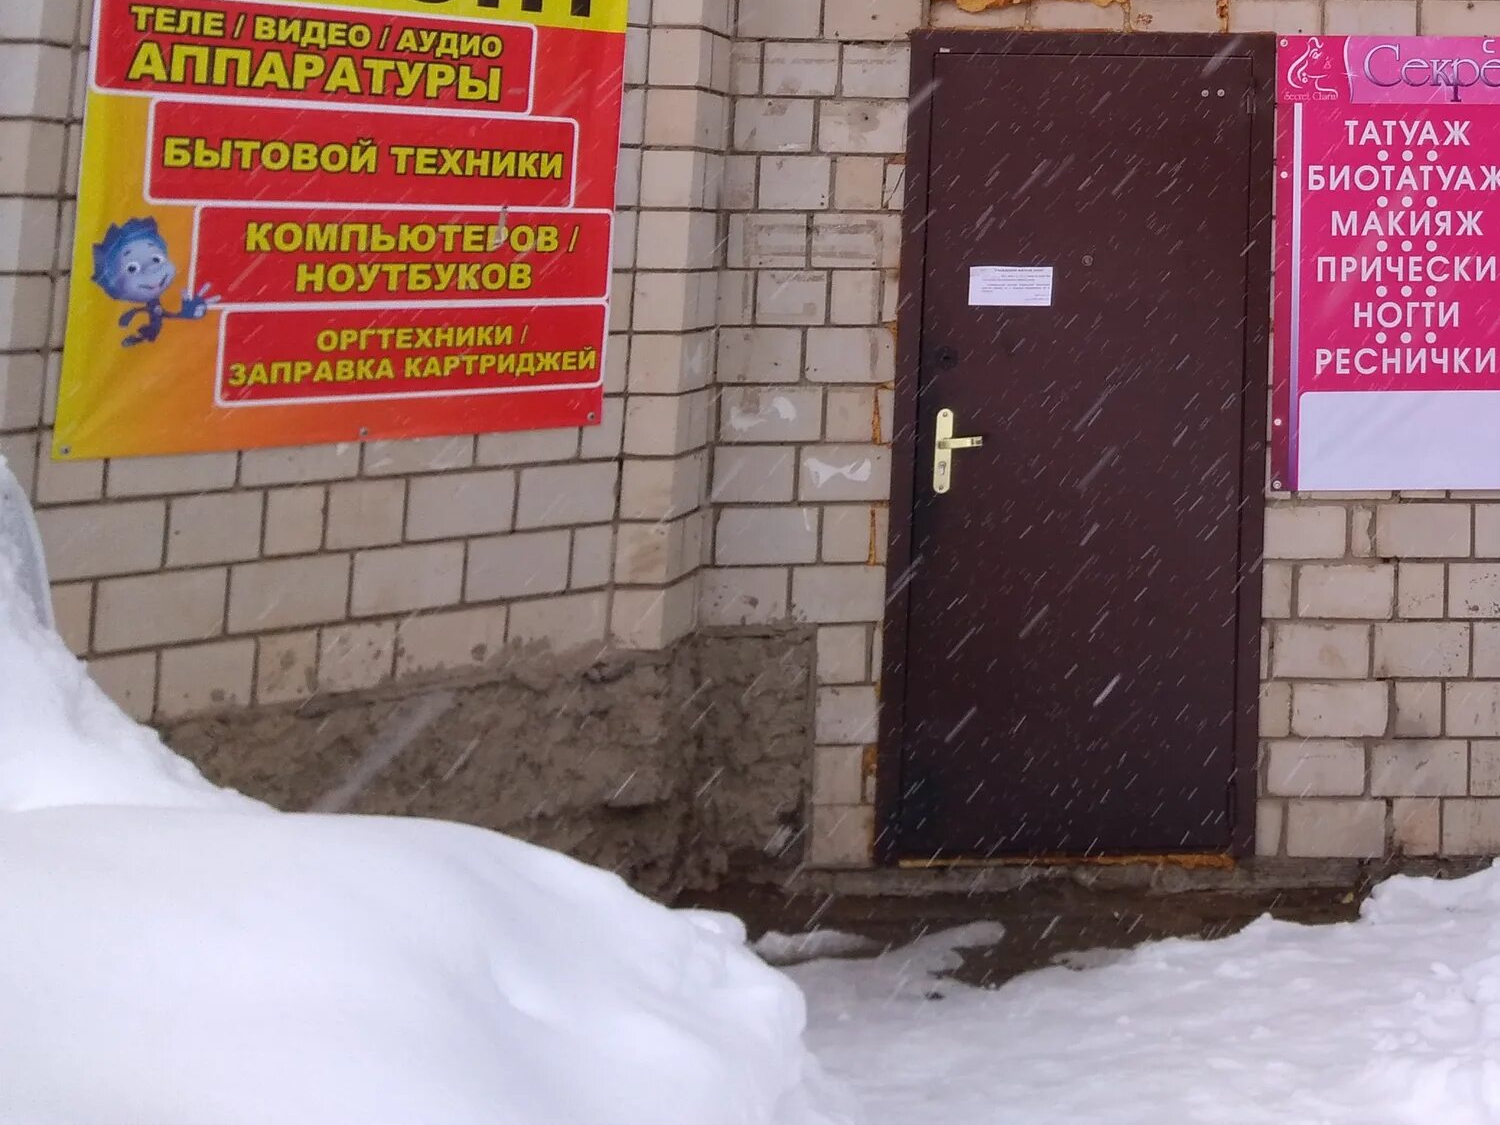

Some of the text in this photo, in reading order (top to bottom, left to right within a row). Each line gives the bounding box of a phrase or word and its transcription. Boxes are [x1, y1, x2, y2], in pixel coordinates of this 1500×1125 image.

[130, 5, 224, 38] ТЕЛЕ
[254, 19, 372, 50] ВИДЕО
[397, 33, 503, 59] АУДИО
[128, 42, 502, 103] АППАРАТУРЫ
[1345, 120, 1471, 147] ТАТУАЖ
[163, 136, 563, 179] БЫТОВОЙ ТЕХНИКИ
[245, 222, 559, 254] КОМПЬЮТЕРОВ
[1331, 211, 1483, 237] МАКИЯЖ
[296, 262, 533, 294] НОУТБУКОВ
[1317, 256, 1497, 283] ПРИЧЕСКИ
[1353, 302, 1460, 328] НОГТИ
[317, 325, 513, 352] ОРГТЕХНИКИ
[229, 349, 596, 386] ЗАПРАВКА КАРТРИДЖЕЙ
[1315, 348, 1497, 375] РЕСНИЧКИ
